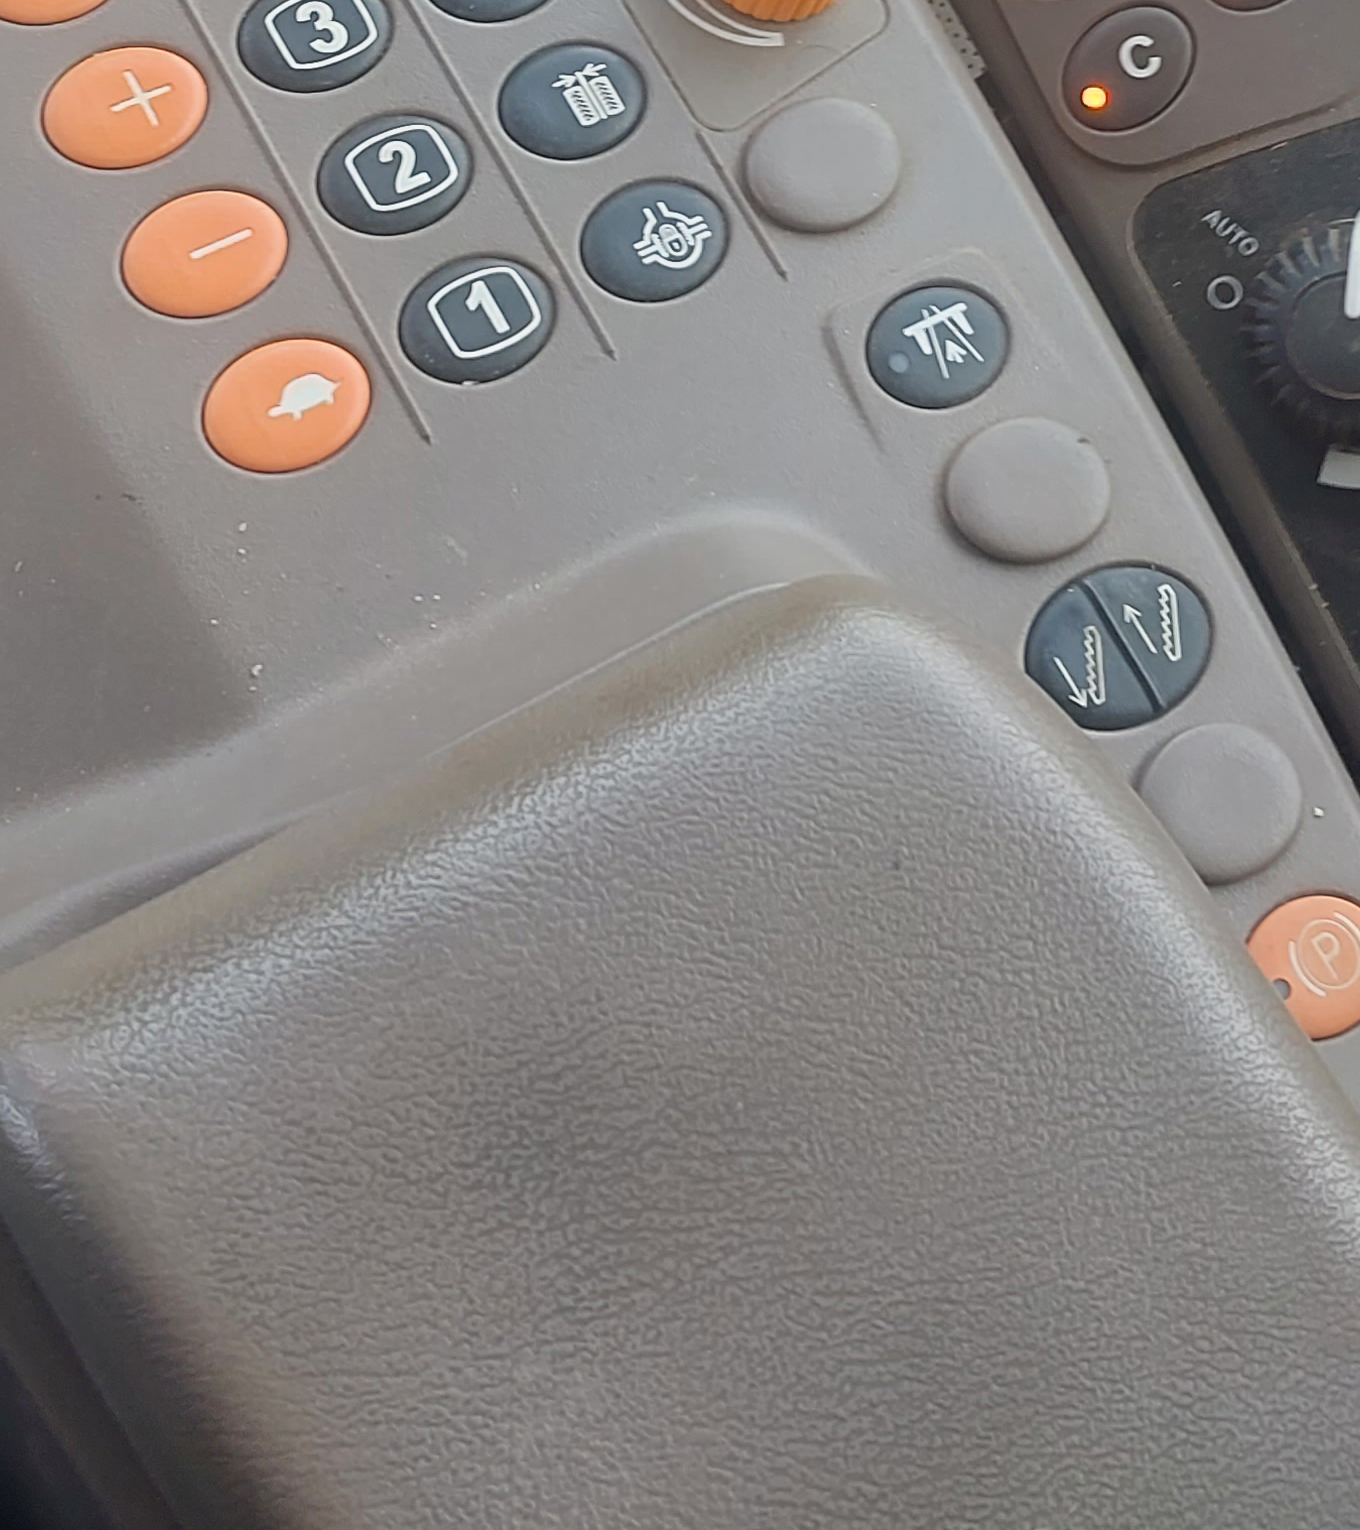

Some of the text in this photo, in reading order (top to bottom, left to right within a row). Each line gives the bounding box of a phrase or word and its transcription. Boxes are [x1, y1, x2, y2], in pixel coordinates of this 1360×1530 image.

[295, 0, 350, 53] 3
[1118, 35, 1162, 79] C
[379, 140, 431, 194] 2
[1201, 209, 1261, 257] AUTO
[465, 280, 511, 335] 1
[1311, 931, 1341, 981] P
